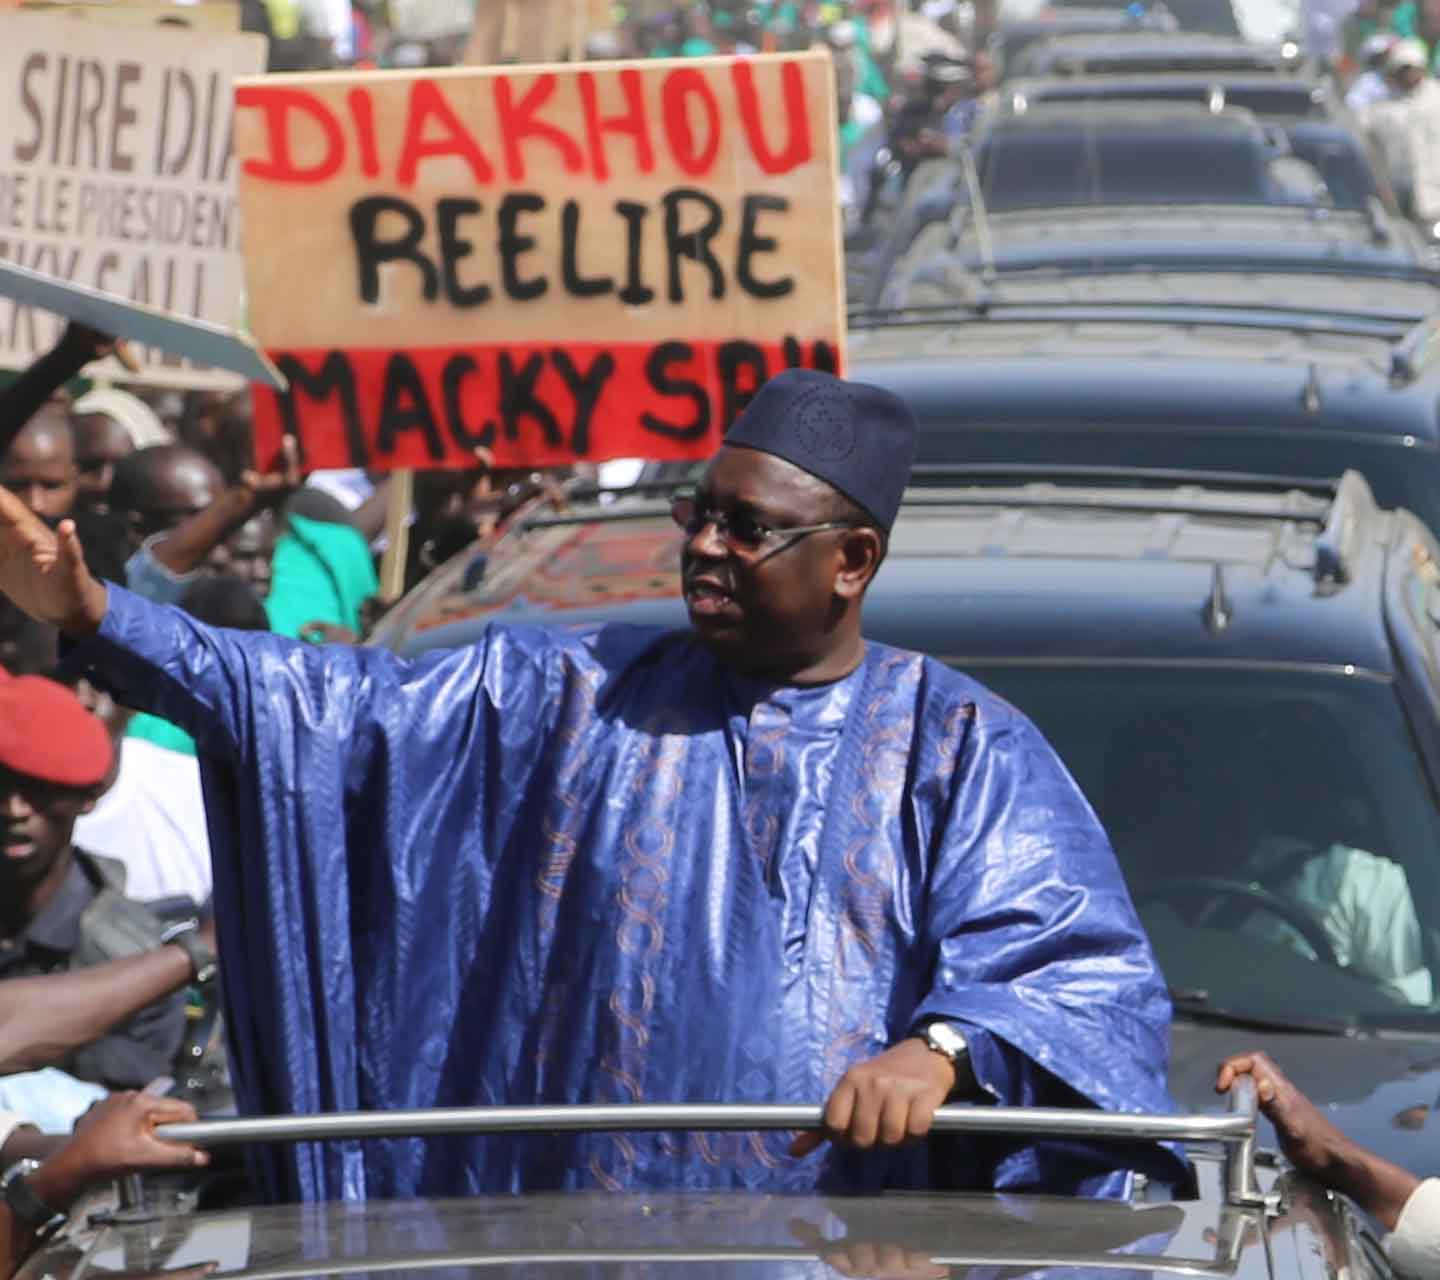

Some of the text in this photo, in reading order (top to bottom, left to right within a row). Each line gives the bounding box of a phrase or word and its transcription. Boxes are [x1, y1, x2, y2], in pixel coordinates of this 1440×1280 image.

[13, 50, 143, 175] SIRE
[234, 58, 814, 188] DIAKHOU
[34, 172, 76, 234] LE
[348, 186, 796, 308] REELIRE
[276, 348, 616, 470] MACKY
